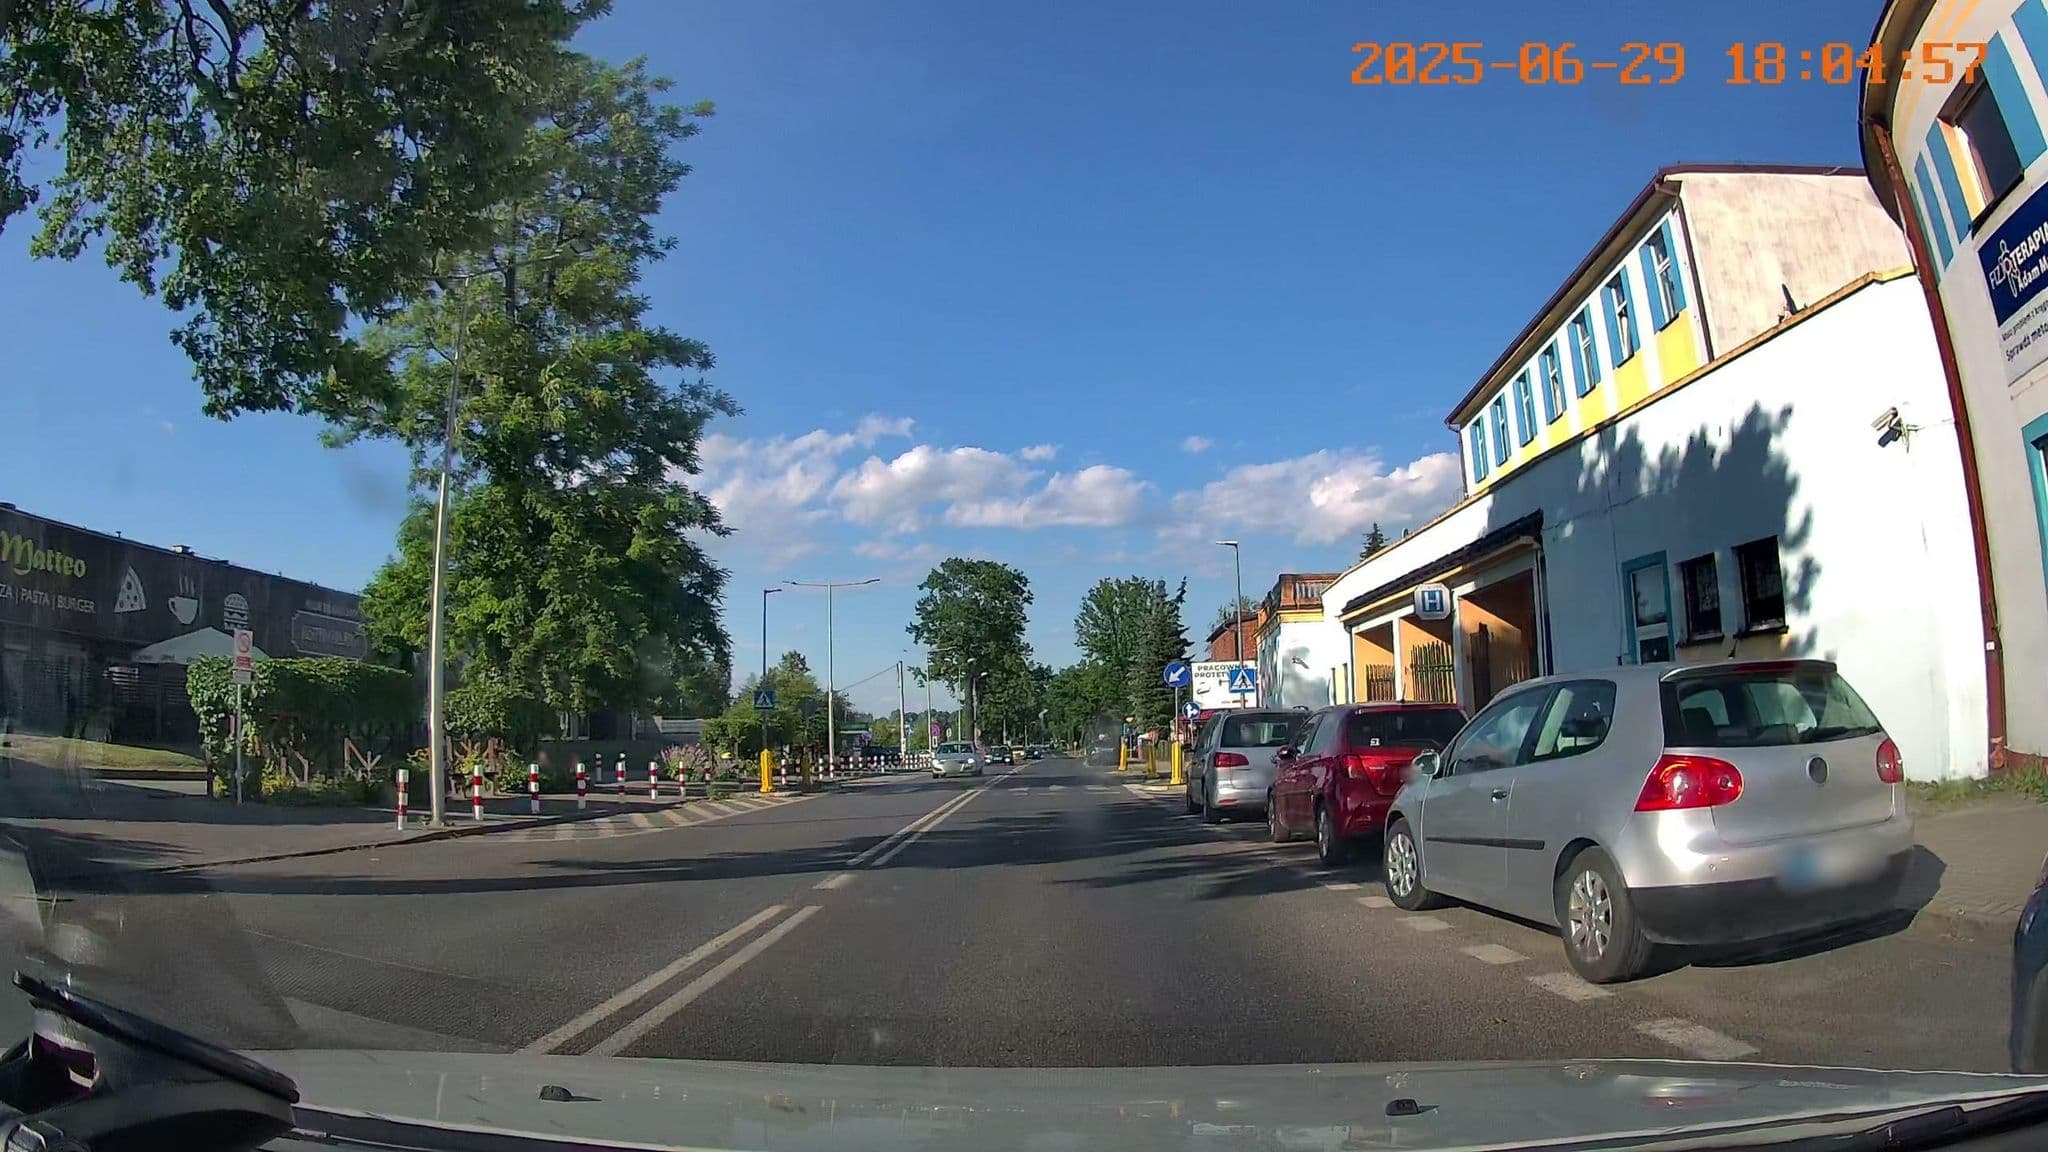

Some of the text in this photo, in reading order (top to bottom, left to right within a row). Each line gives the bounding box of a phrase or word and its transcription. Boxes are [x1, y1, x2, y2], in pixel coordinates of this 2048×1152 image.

[0, 530, 87, 578] Matteo
[21, 587, 50, 607] PASTA
[57, 594, 96, 614] BURGER
[1424, 591, 1441, 611] H
